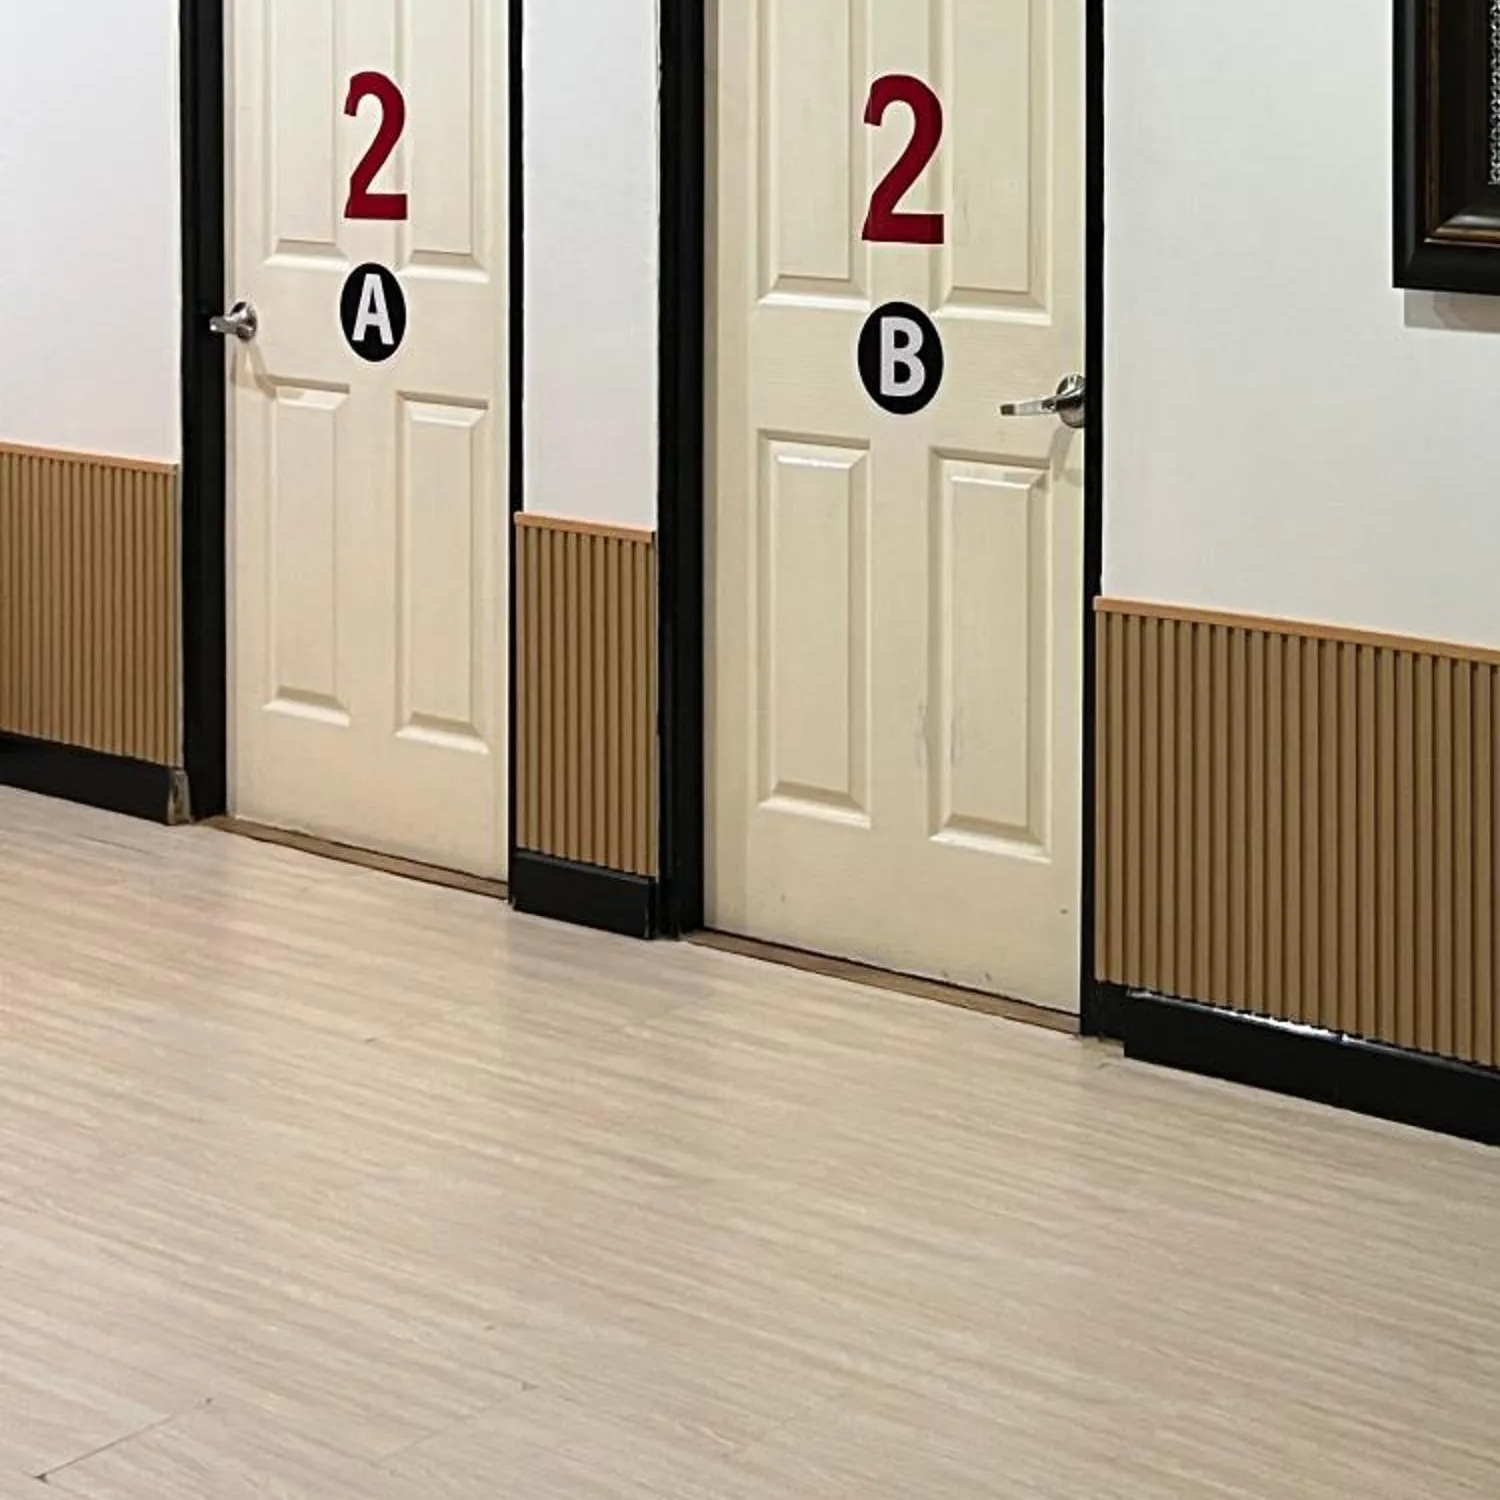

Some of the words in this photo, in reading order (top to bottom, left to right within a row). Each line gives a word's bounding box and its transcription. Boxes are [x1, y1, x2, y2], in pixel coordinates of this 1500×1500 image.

[343, 70, 408, 221] 2
[861, 73, 945, 245] 2
[351, 272, 395, 346] A
[879, 315, 927, 398] B
